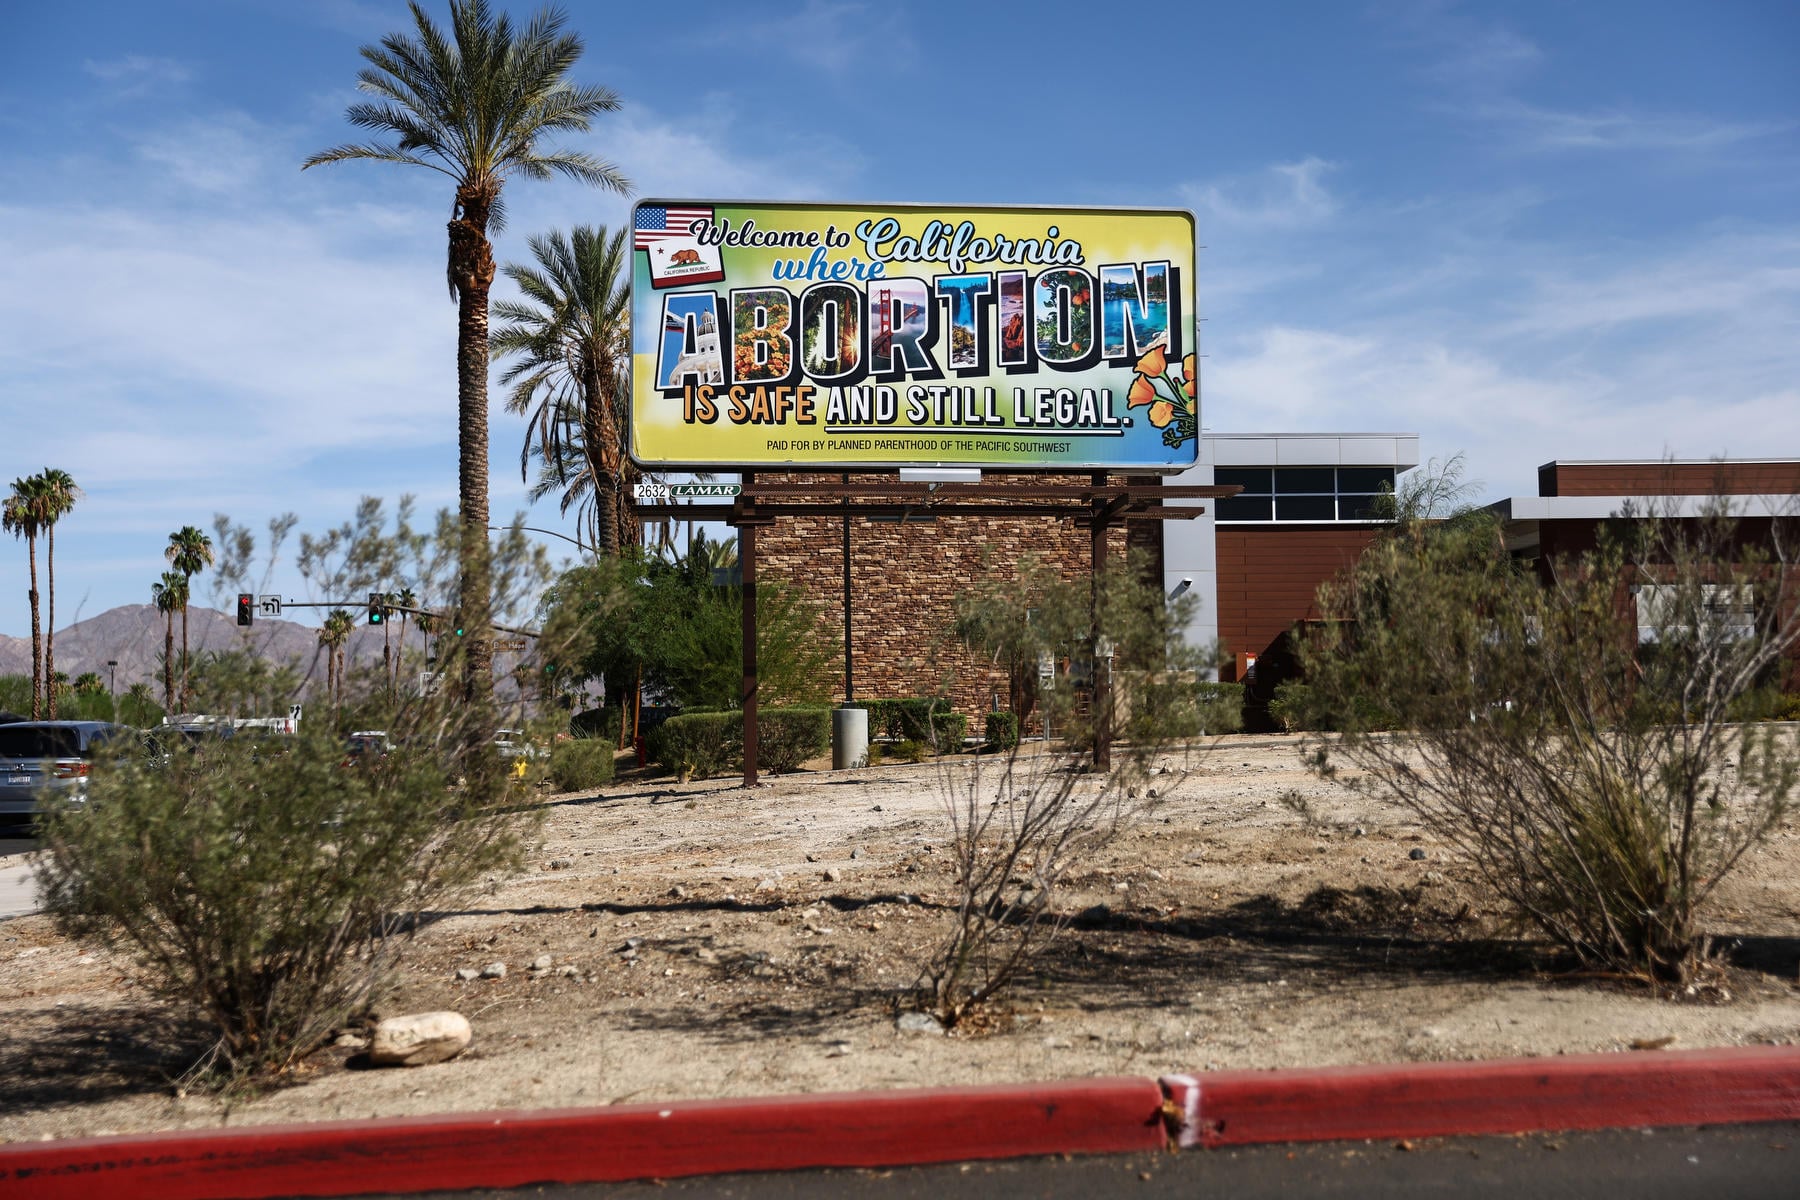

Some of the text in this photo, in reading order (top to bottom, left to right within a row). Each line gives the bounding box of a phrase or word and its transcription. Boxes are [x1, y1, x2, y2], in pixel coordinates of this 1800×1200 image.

[689, 218, 1085, 273] Welcome to California
[773, 246, 887, 281] where
[655, 260, 1182, 398] ABORTION
[684, 385, 1134, 428] IS SAFE AND STILL LEGAL.
[767, 440, 1072, 453] PAID FOR BY PLANNED PARENTHOOD OF THE PACIFIC SOUTHWEST
[638, 485, 666, 498] 2632
[675, 486, 734, 496] LAMAR
